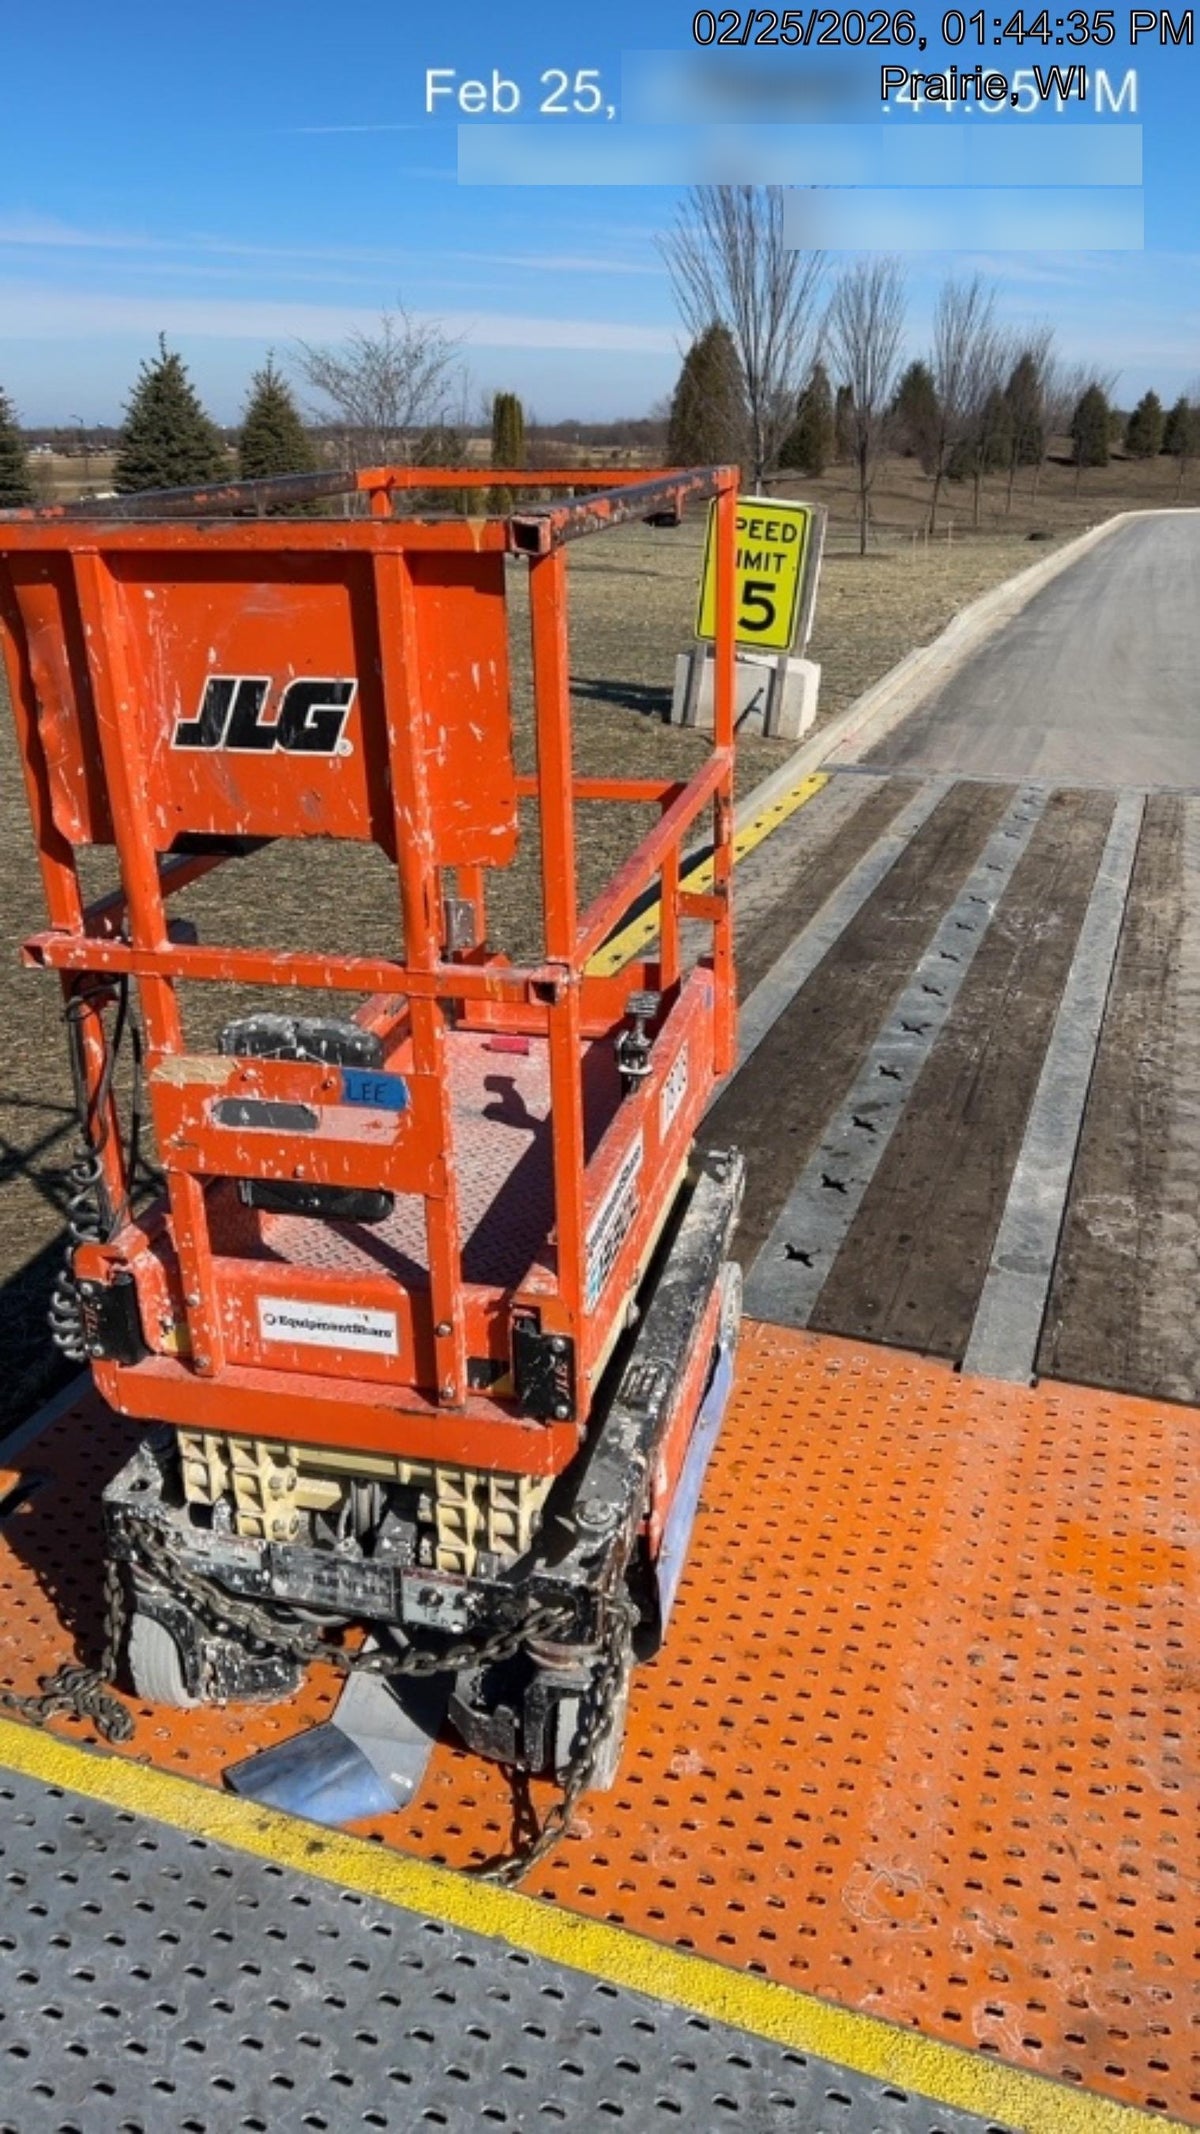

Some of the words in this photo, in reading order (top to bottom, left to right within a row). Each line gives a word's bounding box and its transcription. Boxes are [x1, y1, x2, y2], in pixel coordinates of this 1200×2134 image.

[735, 517, 797, 544] PEED
[735, 548, 787, 573] IMIT
[161, 675, 358, 757] JLG
[279, 1315, 394, 1338] EquipmentShare
